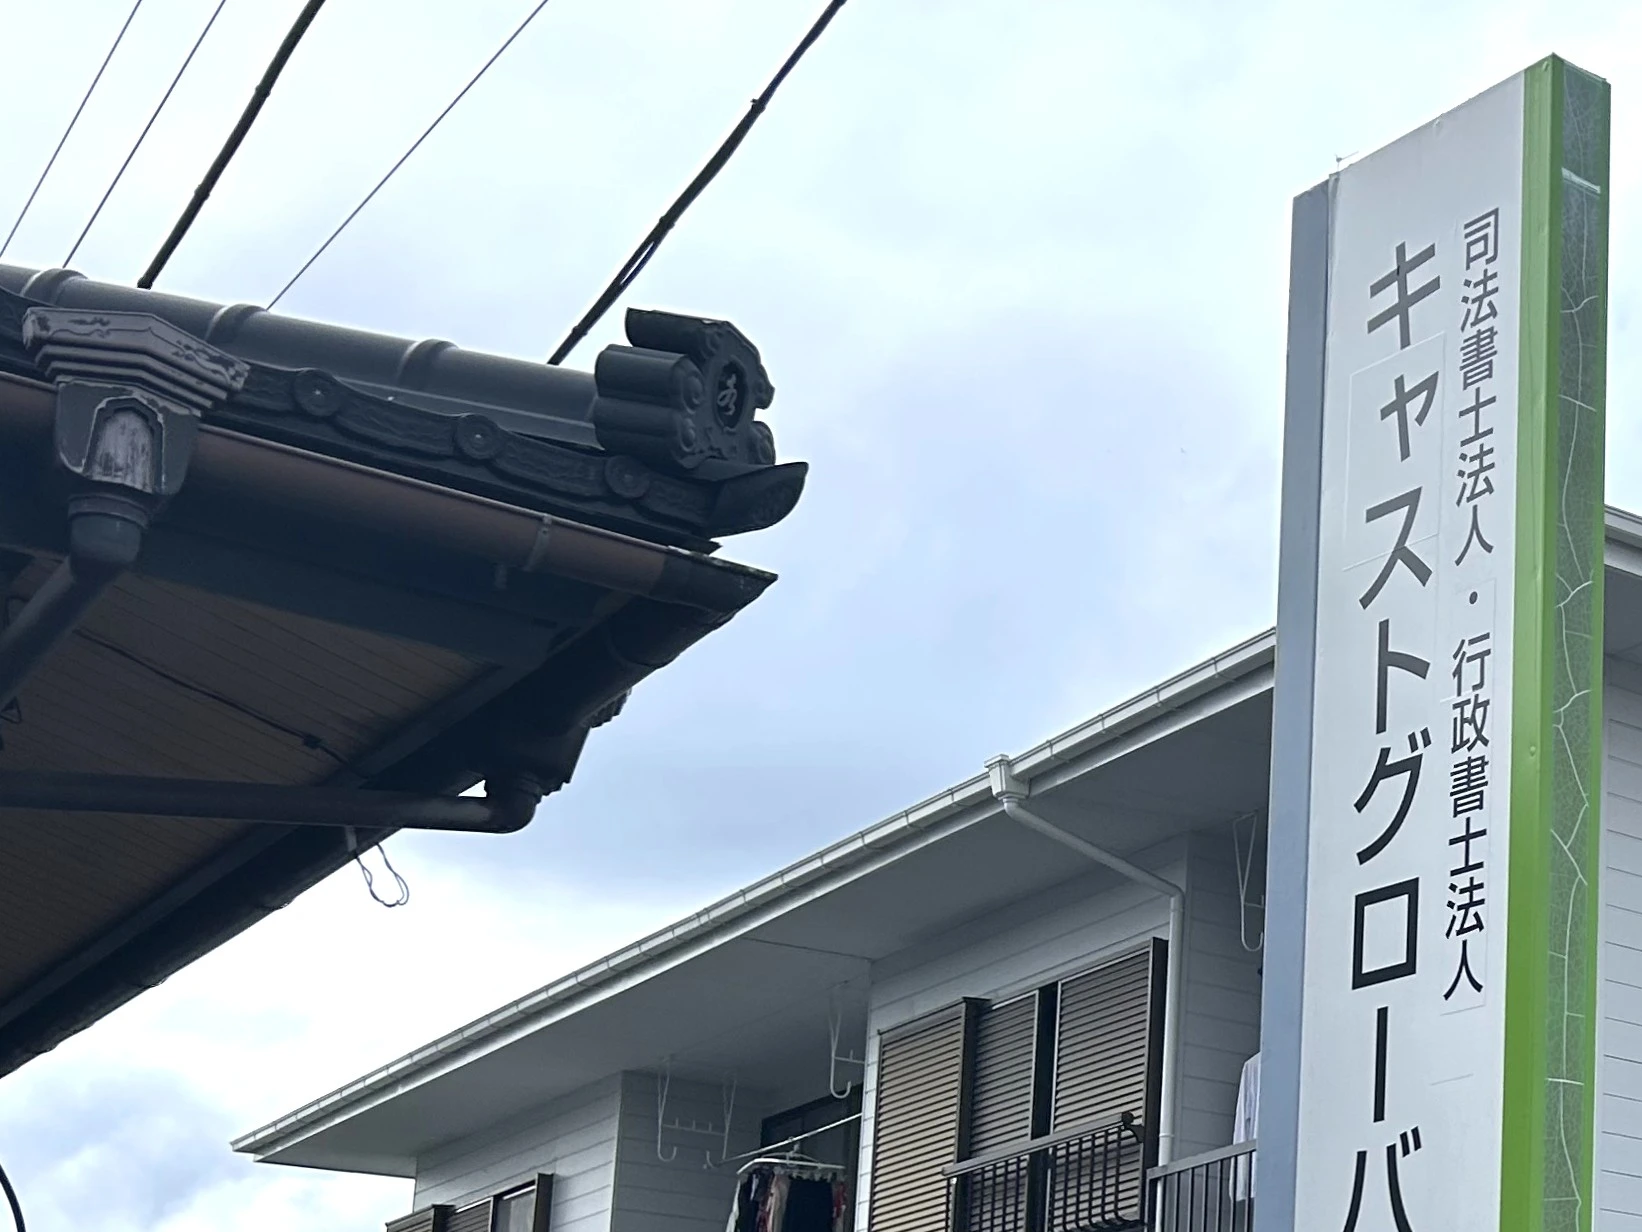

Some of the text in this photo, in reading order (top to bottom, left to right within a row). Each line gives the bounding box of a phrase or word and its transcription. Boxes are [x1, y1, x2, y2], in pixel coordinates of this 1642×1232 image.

[1443, 207, 1501, 1001] 司法書士法人・行政書士法人
